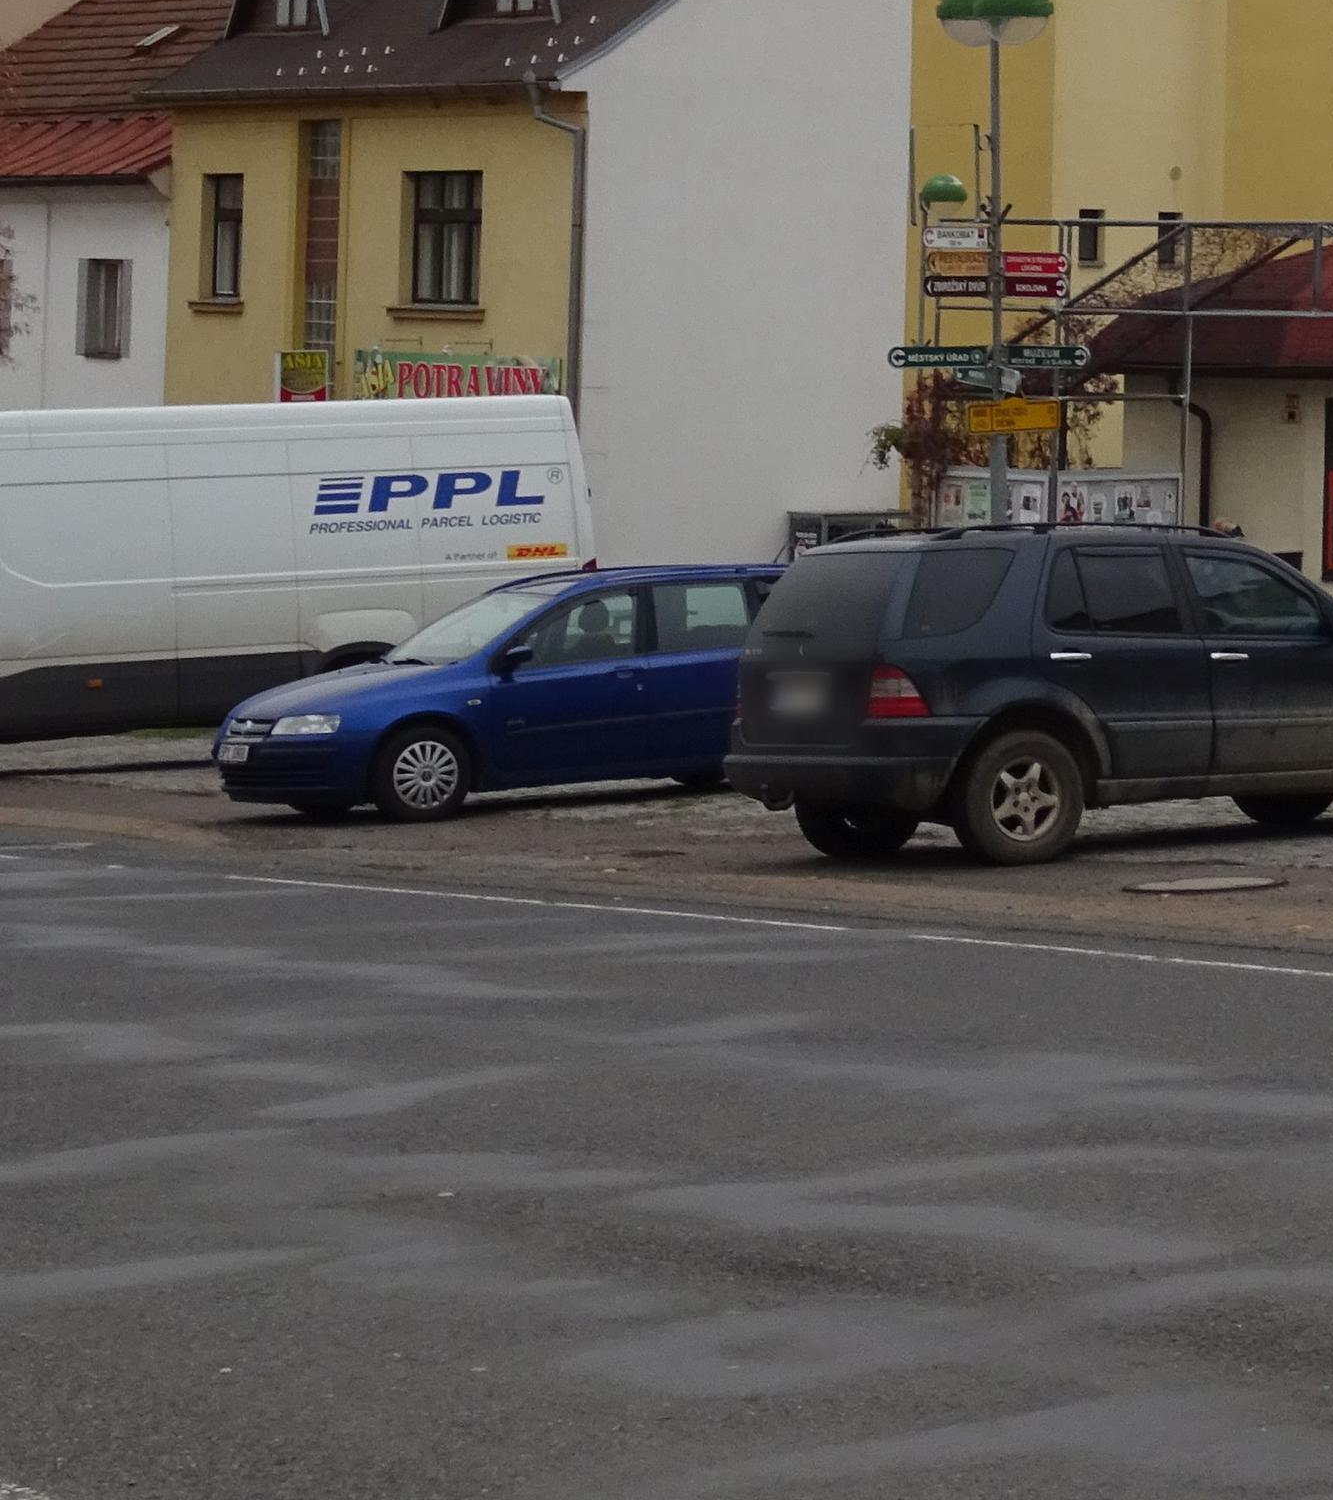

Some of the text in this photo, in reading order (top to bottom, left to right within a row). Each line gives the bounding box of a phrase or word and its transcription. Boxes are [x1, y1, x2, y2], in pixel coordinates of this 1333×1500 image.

[367, 470, 545, 513] PPL
[309, 512, 542, 535] PROFESSIONAL PARCEL LOGISTIC
[515, 544, 562, 557] DHL
